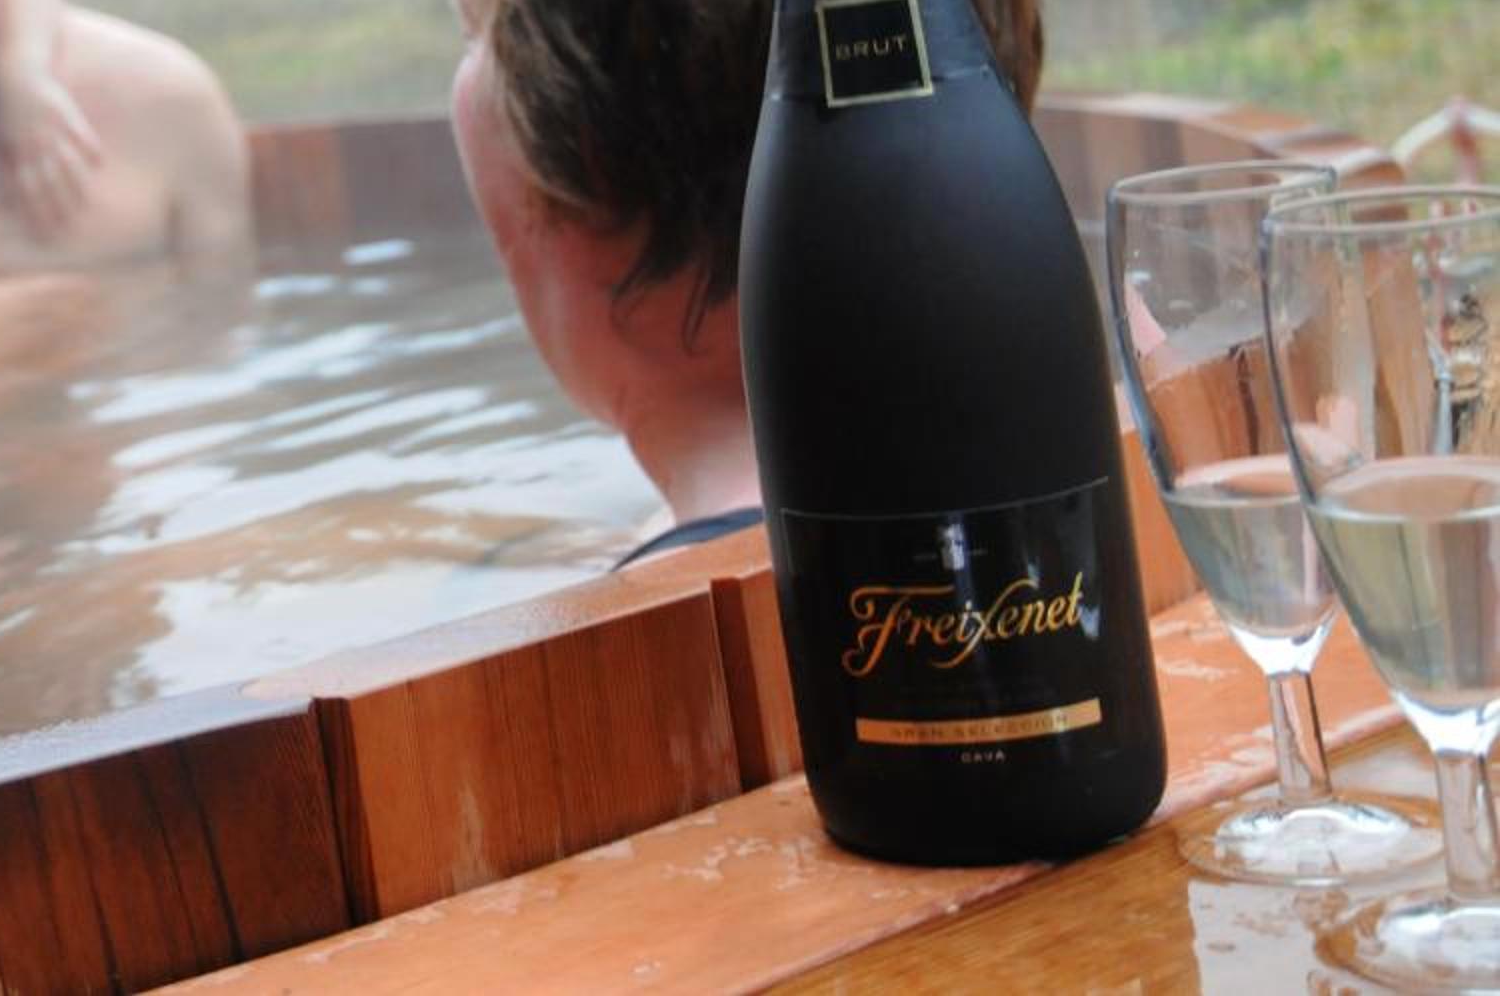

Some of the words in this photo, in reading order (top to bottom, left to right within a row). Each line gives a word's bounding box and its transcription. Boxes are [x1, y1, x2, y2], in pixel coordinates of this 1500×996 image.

[835, 34, 907, 60] BRUT
[842, 571, 1084, 678] Freixenet
[960, 750, 1006, 764] CAVA
